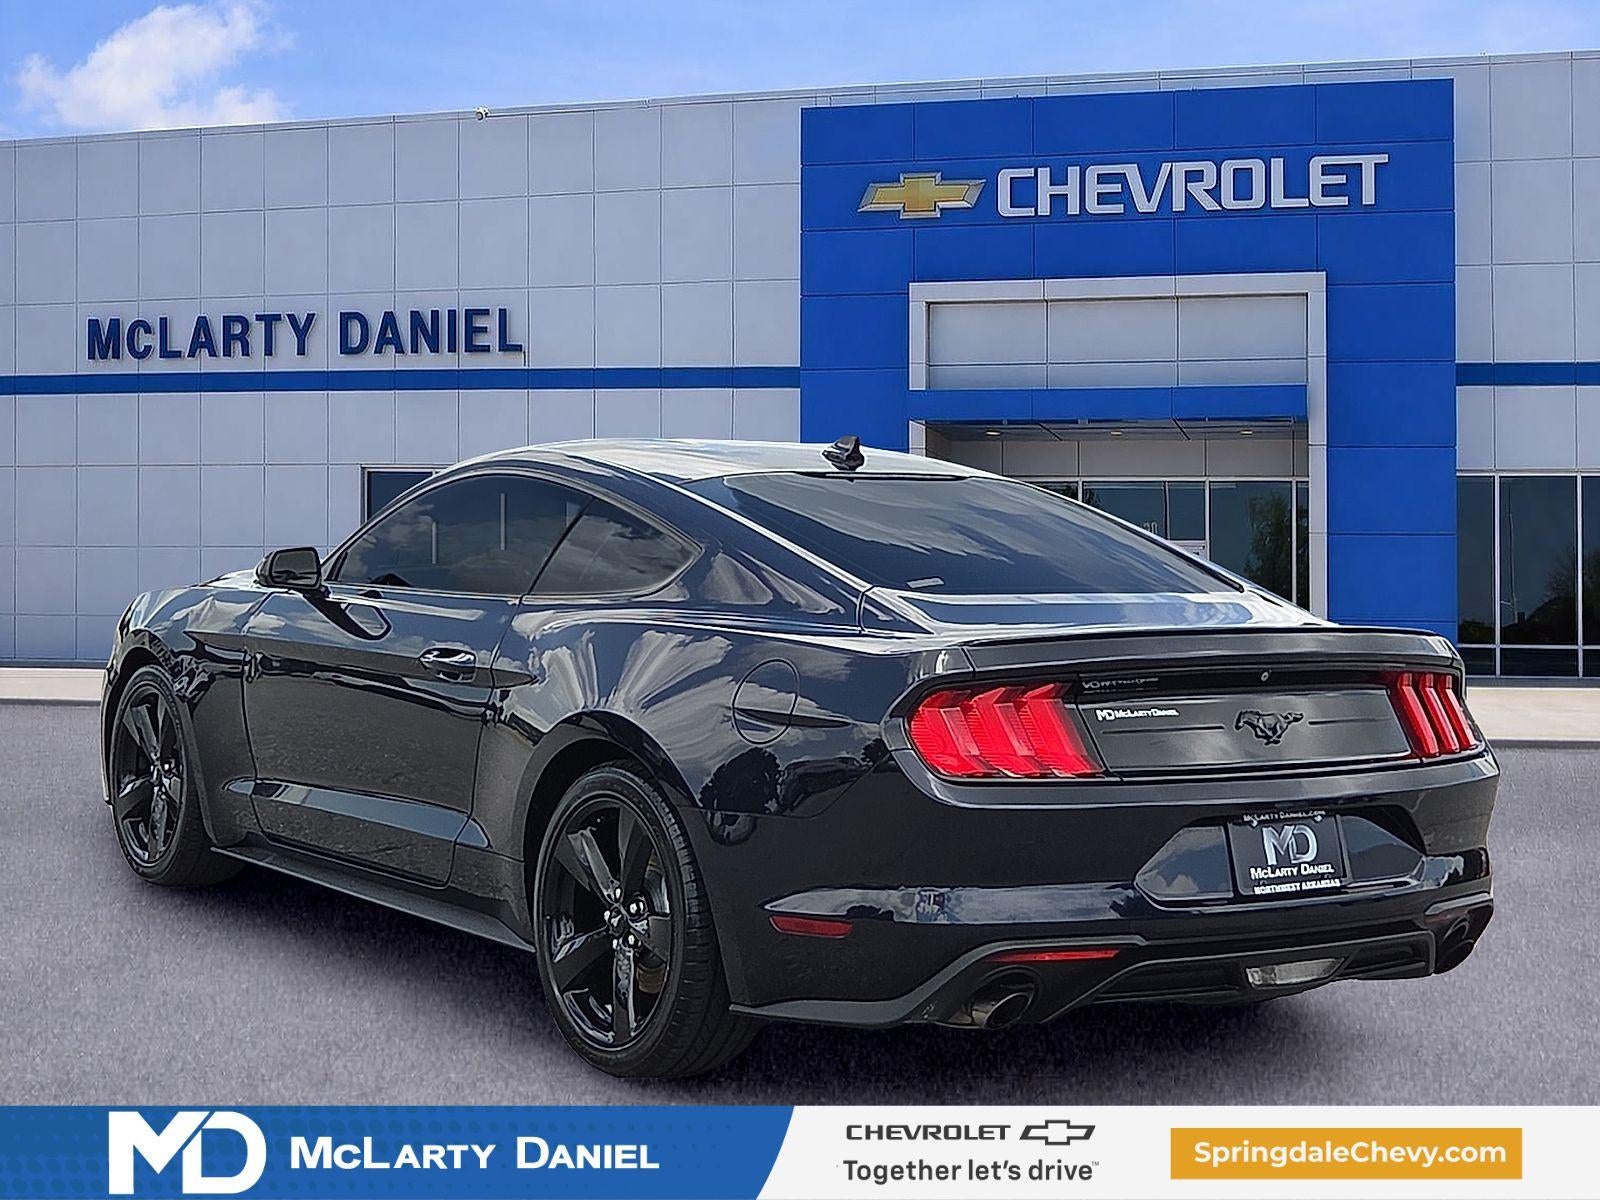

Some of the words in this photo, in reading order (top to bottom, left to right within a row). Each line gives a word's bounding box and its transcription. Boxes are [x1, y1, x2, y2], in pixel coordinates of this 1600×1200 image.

[998, 154, 1389, 217] CHEVROLET
[338, 307, 524, 356] DANIEL
[1300, 863, 1335, 876] DANIEL
